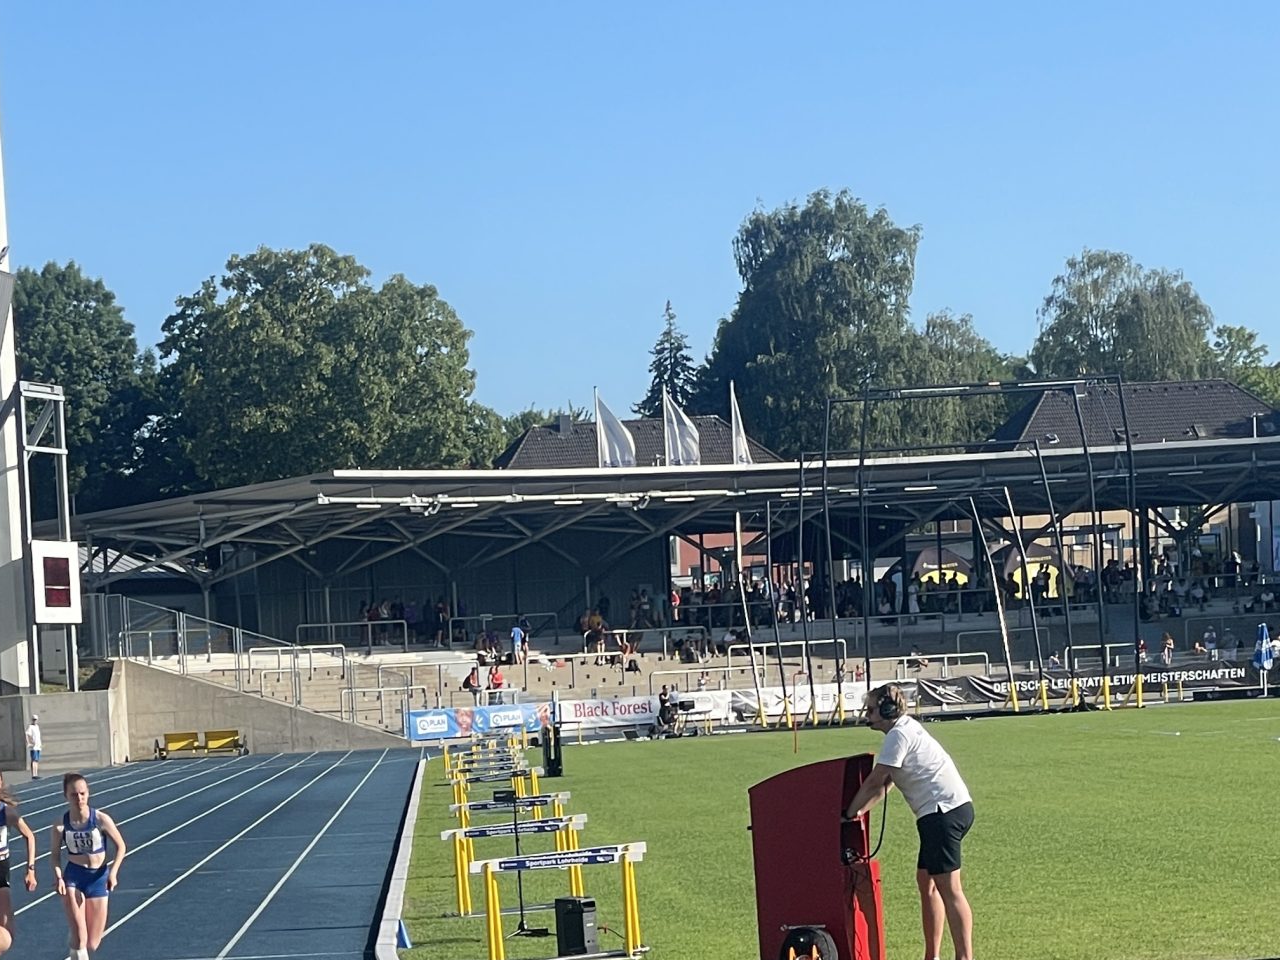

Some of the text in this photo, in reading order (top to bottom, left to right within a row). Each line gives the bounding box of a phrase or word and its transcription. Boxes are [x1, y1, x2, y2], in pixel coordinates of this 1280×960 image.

[1142, 667, 1246, 684] MEISTERSCHAFTEN
[573, 700, 653, 718] Black Forest
[503, 713, 521, 722] PLAN
[429, 718, 446, 727] PLAN
[73, 832, 91, 840] GLS
[74, 839, 93, 848] 130
[525, 859, 556, 868] Sportpark
[558, 856, 589, 865] Lohrheide
